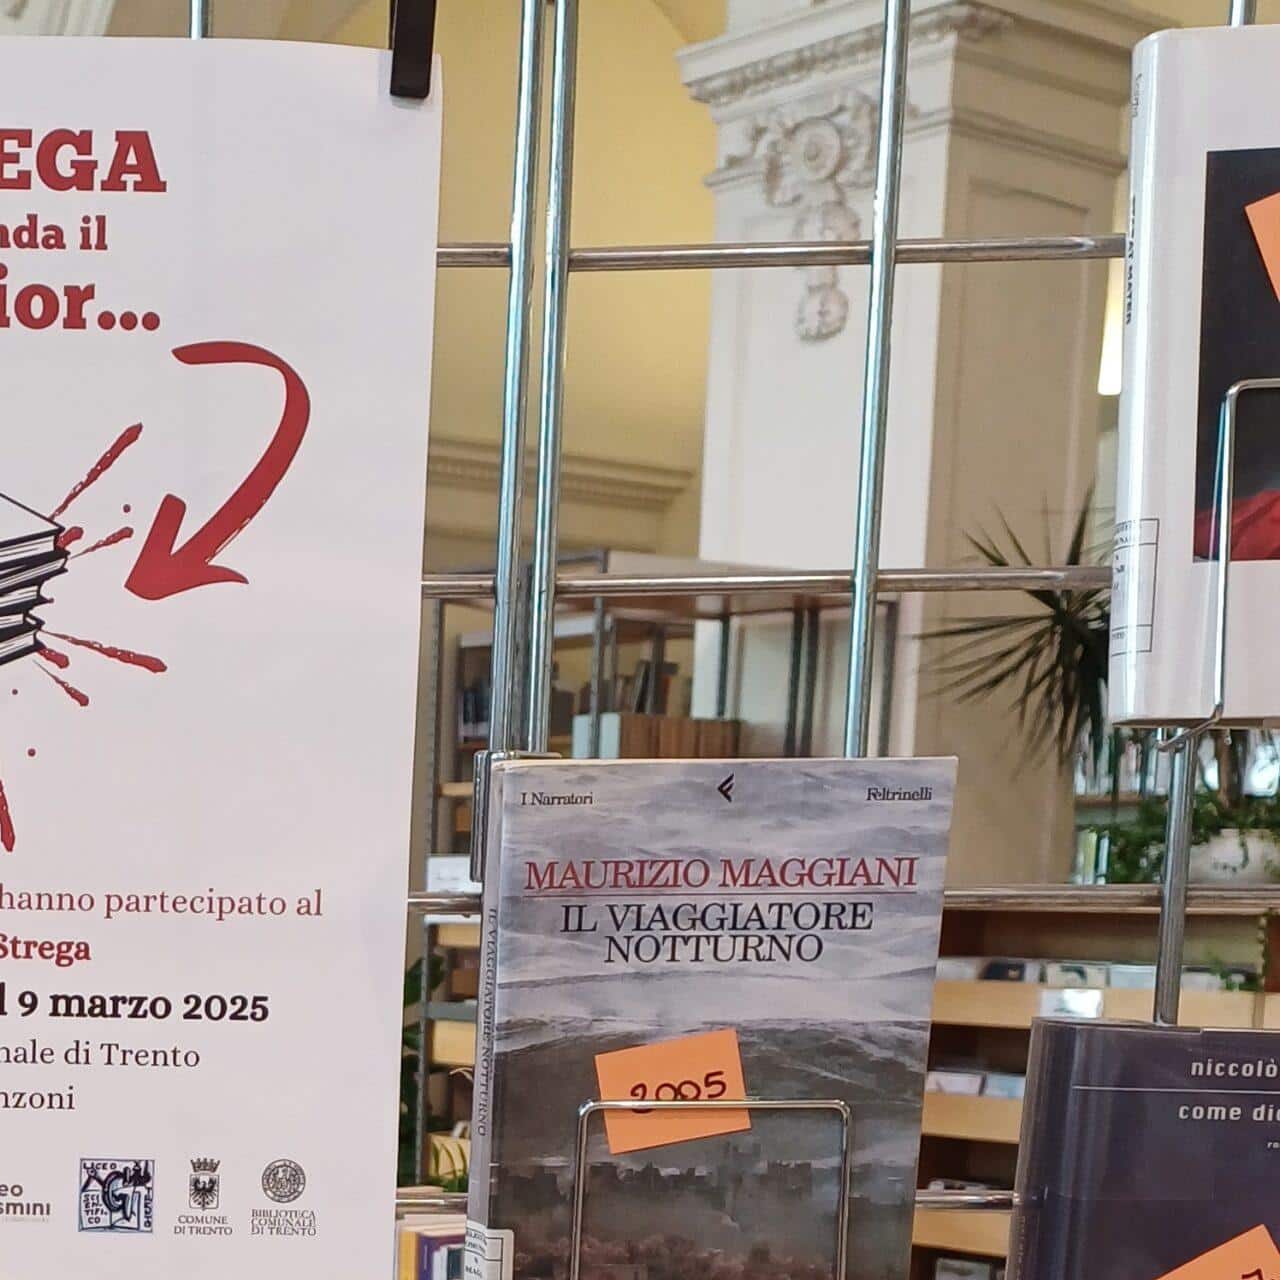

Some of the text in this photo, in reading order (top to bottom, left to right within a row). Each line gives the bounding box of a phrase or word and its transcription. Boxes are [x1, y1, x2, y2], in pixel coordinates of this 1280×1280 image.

[79, 214, 108, 250] il
[521, 792, 593, 806] I Narratori
[867, 787, 932, 802] Feltrinelli
[524, 856, 920, 890] MAURIZIO MAGGIANI
[104, 887, 287, 921] partecipato
[296, 888, 323, 917] al
[560, 901, 874, 933] IL VIAGGIATORE
[604, 934, 823, 964] NOTTURNO
[483, 926, 498, 1042] VIAGGIATORE
[18, 990, 39, 1018] 9
[48, 993, 172, 1019] marzo
[182, 994, 270, 1022] 2025
[64, 1039, 92, 1066] di
[100, 1042, 201, 1068] Trento
[1191, 1058, 1278, 1078] niccolò
[477, 1045, 494, 1137] NOTTURNO
[630, 1070, 727, 1114] 2005
[1179, 1104, 1241, 1121] come
[83, 1162, 118, 1171] LICEO
[177, 1215, 229, 1225] COMUNE
[250, 1217, 315, 1228] COMUNALE
[251, 1208, 316, 1219] BIBLIOTECA
[173, 1225, 233, 1236] DI TRENTO
[251, 1226, 317, 1237] DI TRENTO
